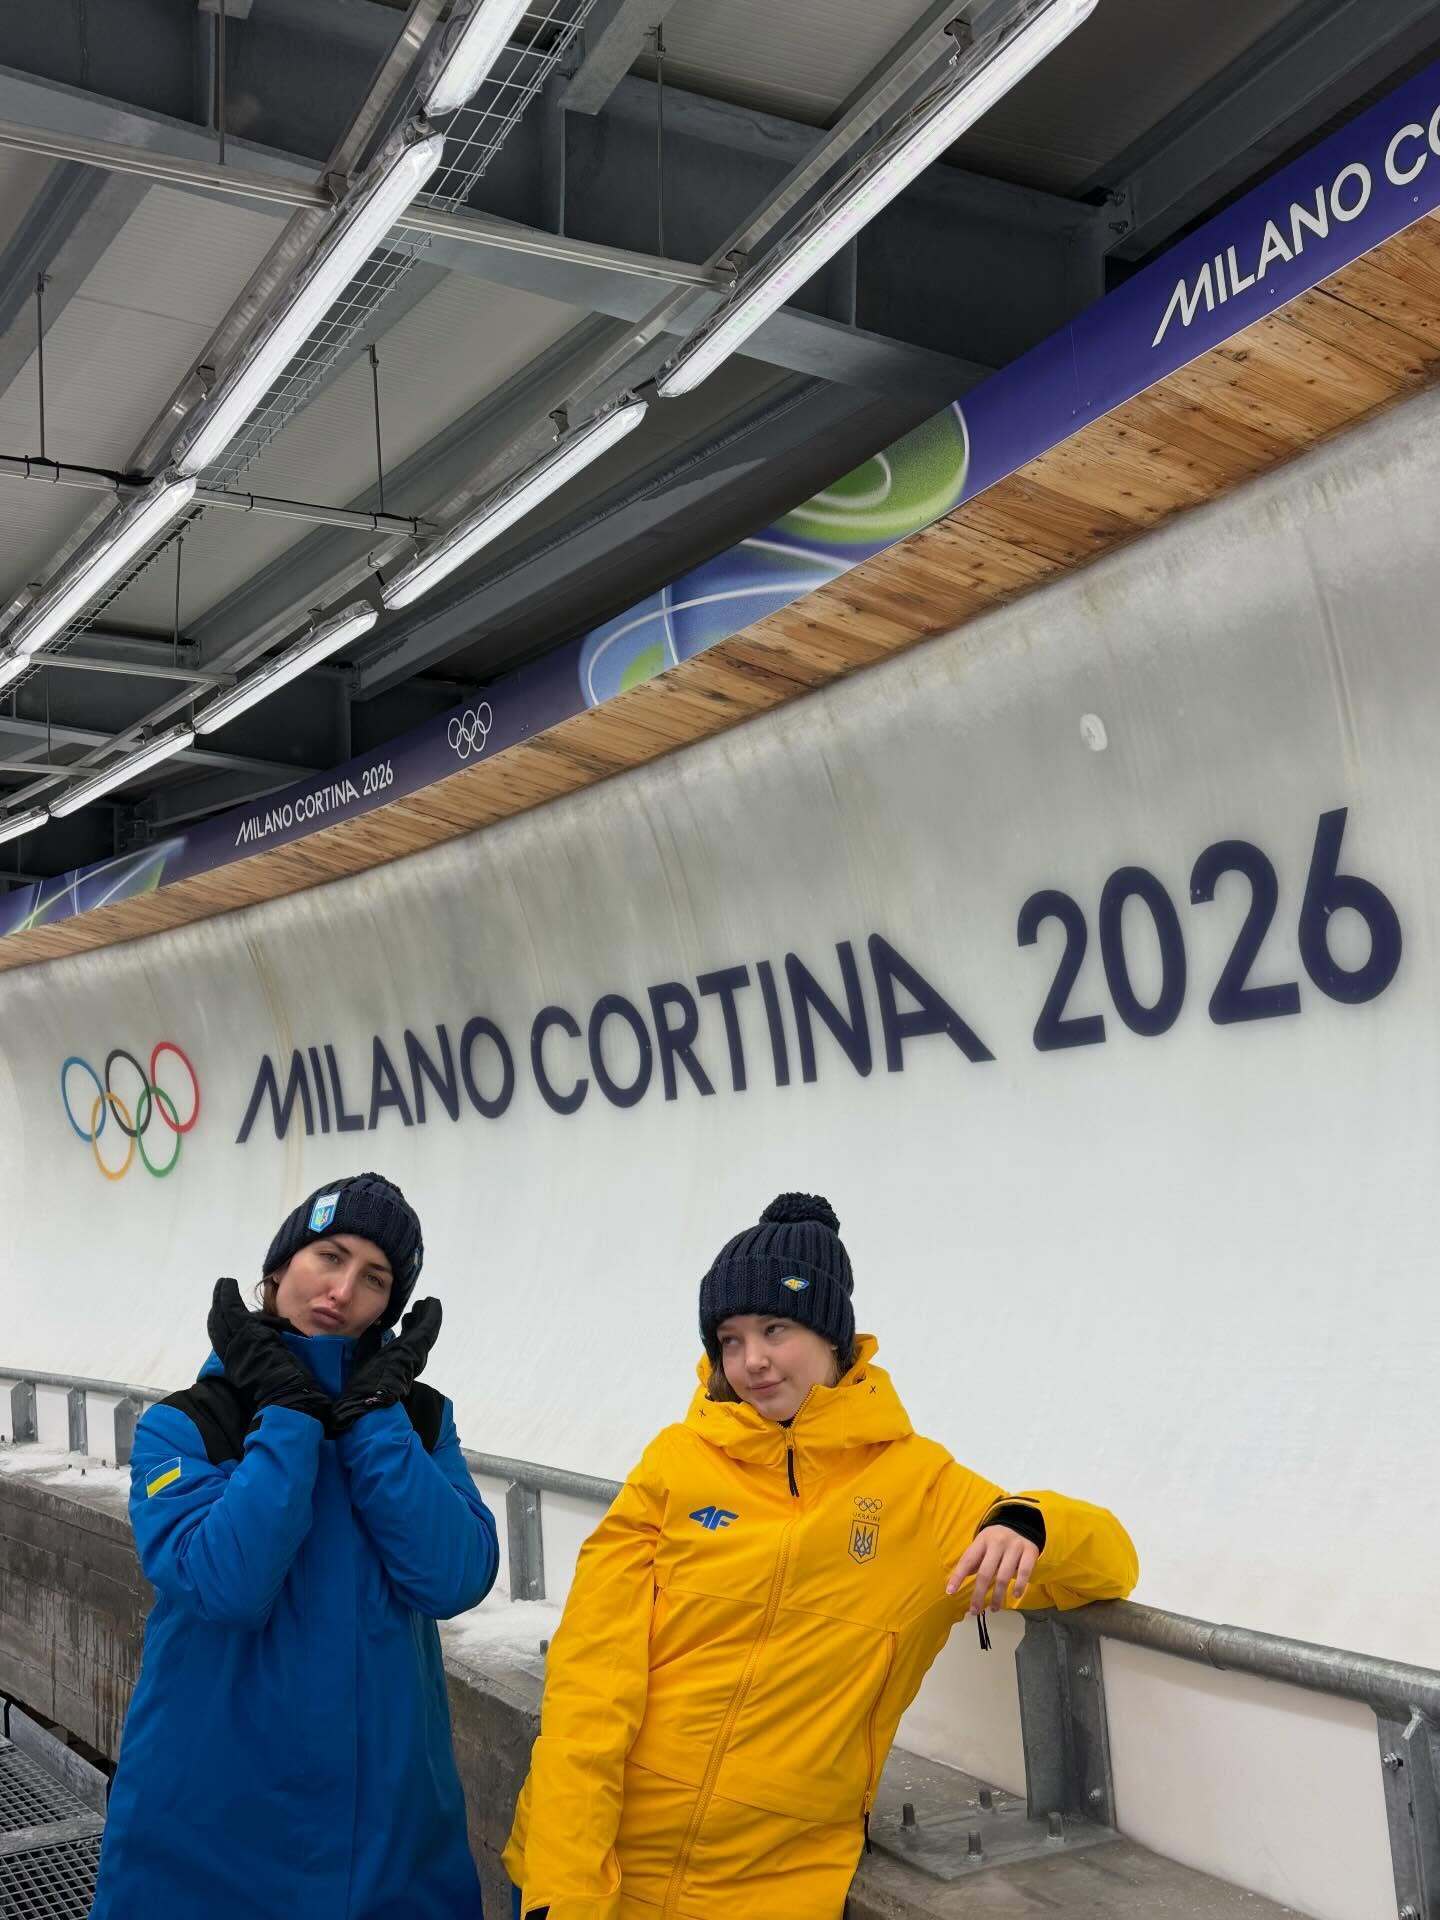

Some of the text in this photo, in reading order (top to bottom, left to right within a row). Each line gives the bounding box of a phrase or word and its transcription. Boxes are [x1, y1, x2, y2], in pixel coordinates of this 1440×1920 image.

[1151, 103, 1440, 348] MILANO C
[235, 760, 394, 846] MILANO CORTINA 2026
[235, 807, 1402, 1144] MILANO CORTINA 2026
[688, 1505, 739, 1531] 4F
